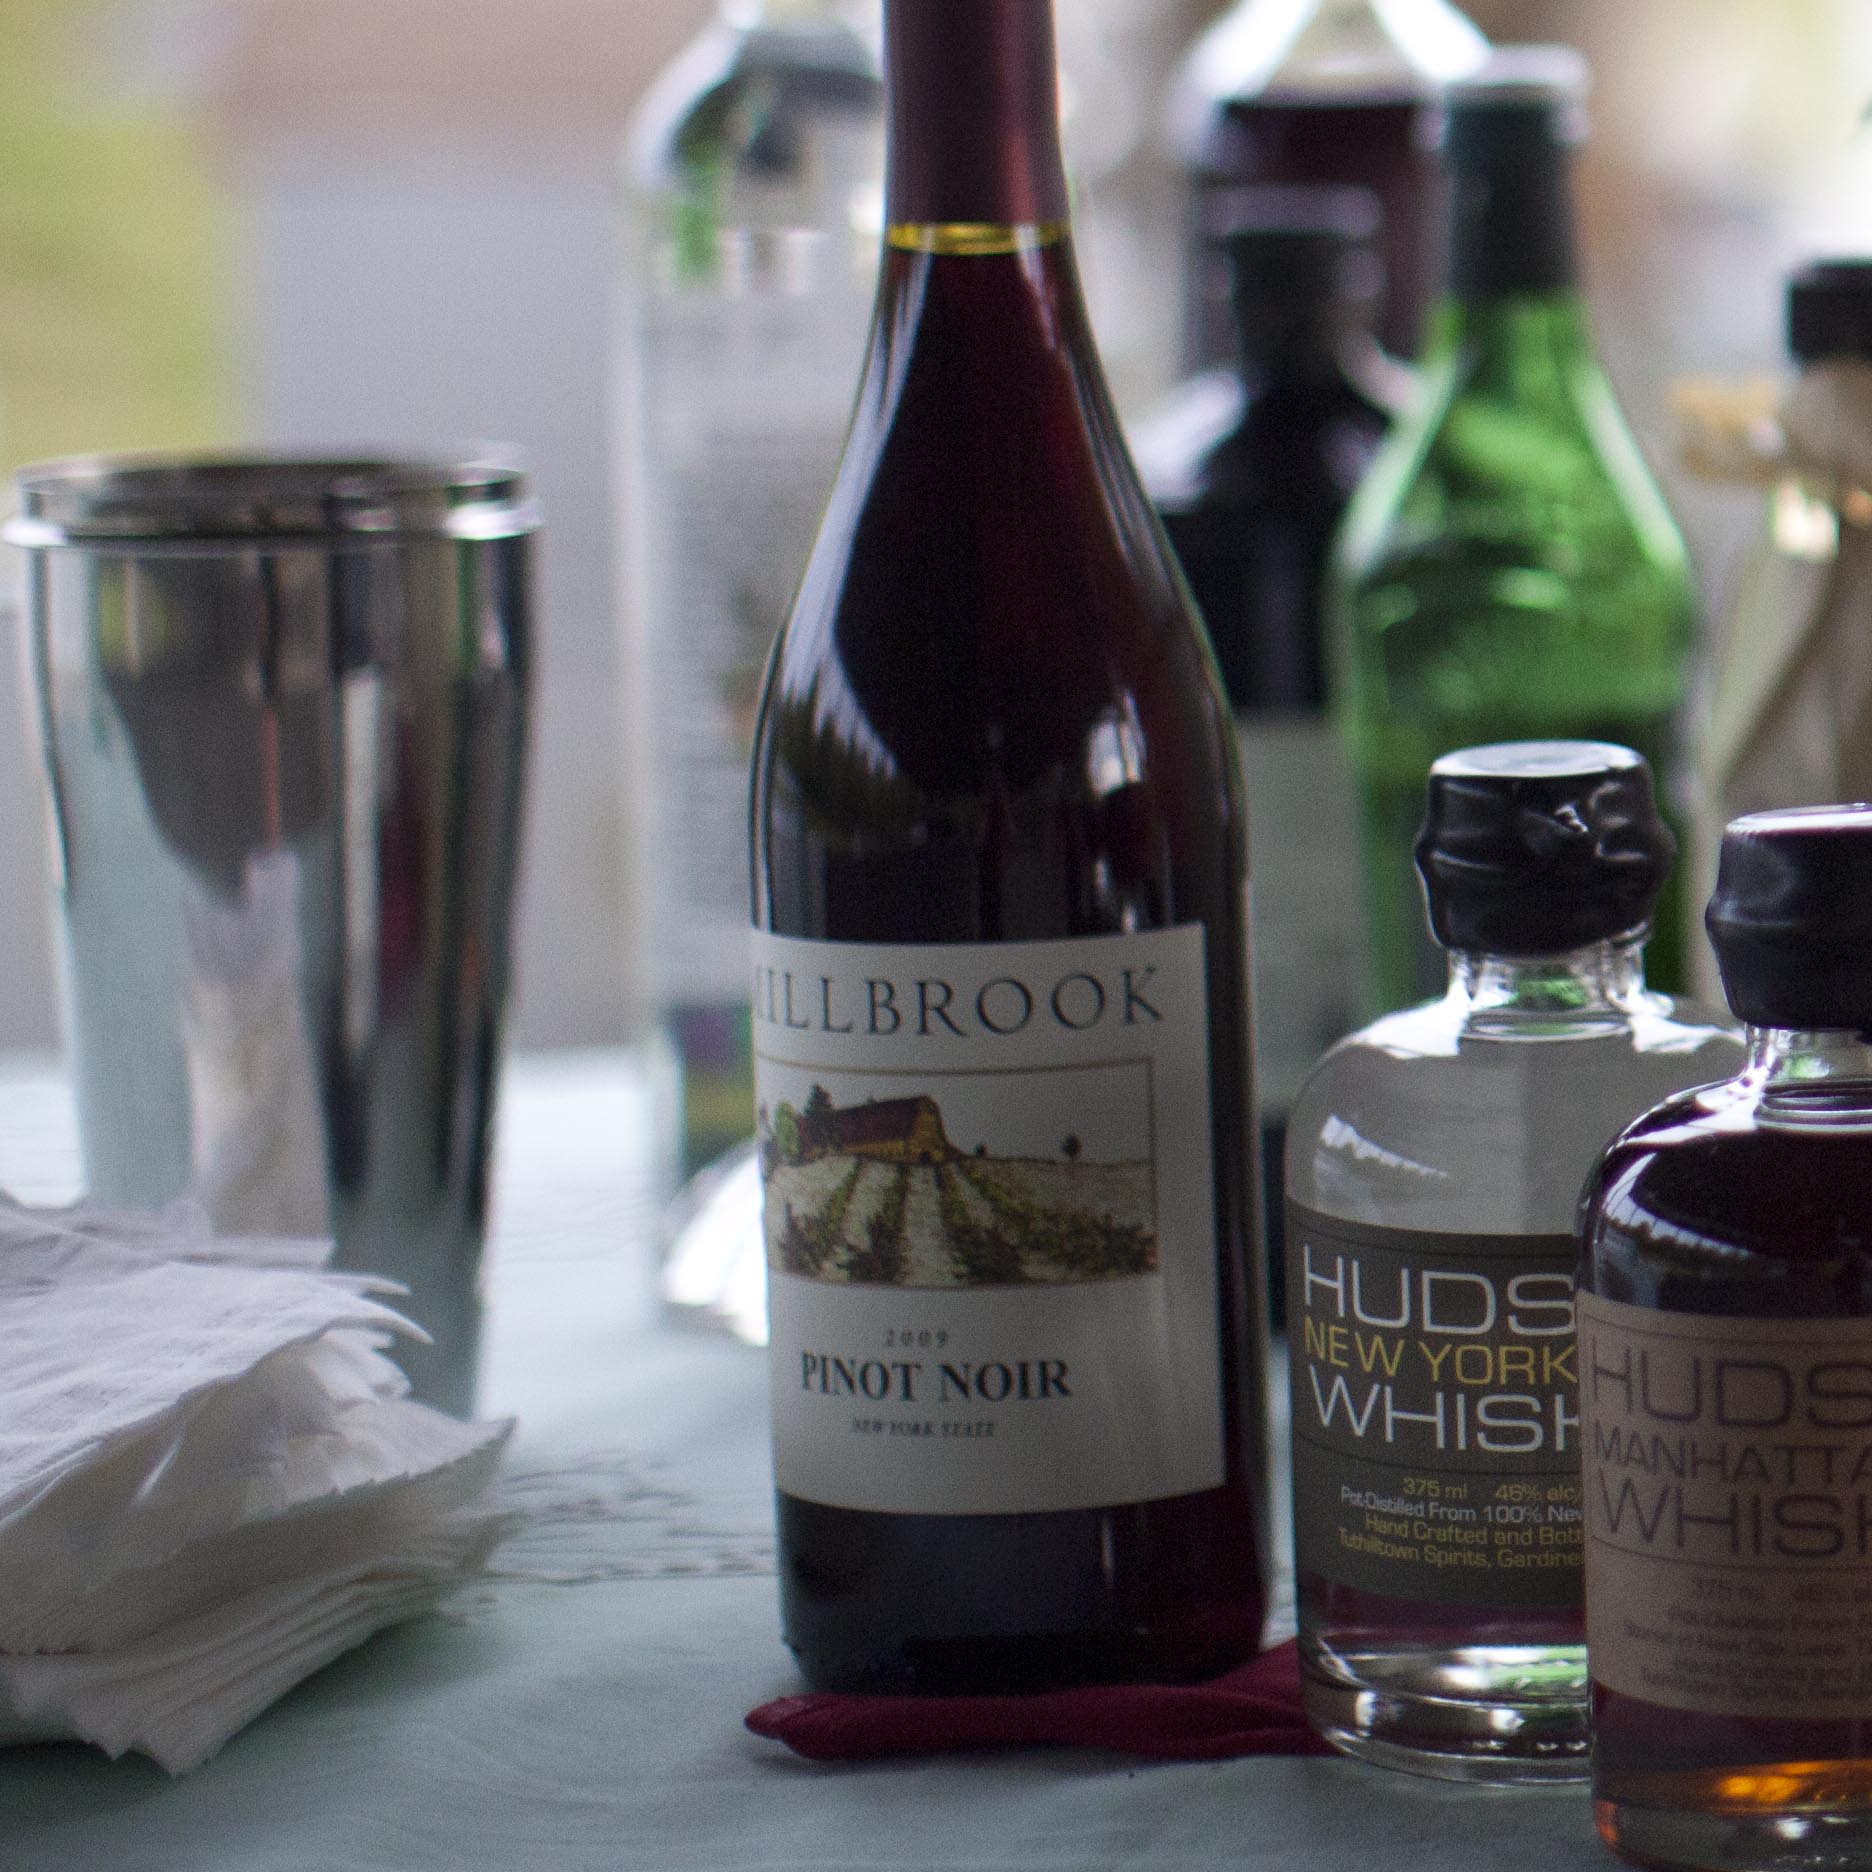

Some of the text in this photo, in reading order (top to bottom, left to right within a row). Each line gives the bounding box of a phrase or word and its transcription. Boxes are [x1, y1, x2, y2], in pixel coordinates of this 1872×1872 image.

[1303, 1243, 1576, 1337] HUDS
[801, 1349, 1073, 1402] PINOT NOIR
[1304, 1315, 1578, 1385] NEW YORK
[1310, 1364, 1580, 1453] WHIS
[1340, 1483, 1425, 1517] Pot-Distilled
[1428, 1502, 1477, 1521] From
[1483, 1504, 1543, 1523] 100%
[1403, 1476, 1440, 1497] 375
[1444, 1482, 1468, 1500] ml
[1494, 1483, 1542, 1502] 46%
[1365, 1512, 1409, 1539] Hand
[1413, 1520, 1488, 1545] Crafted
[1494, 1527, 1533, 1546] and
